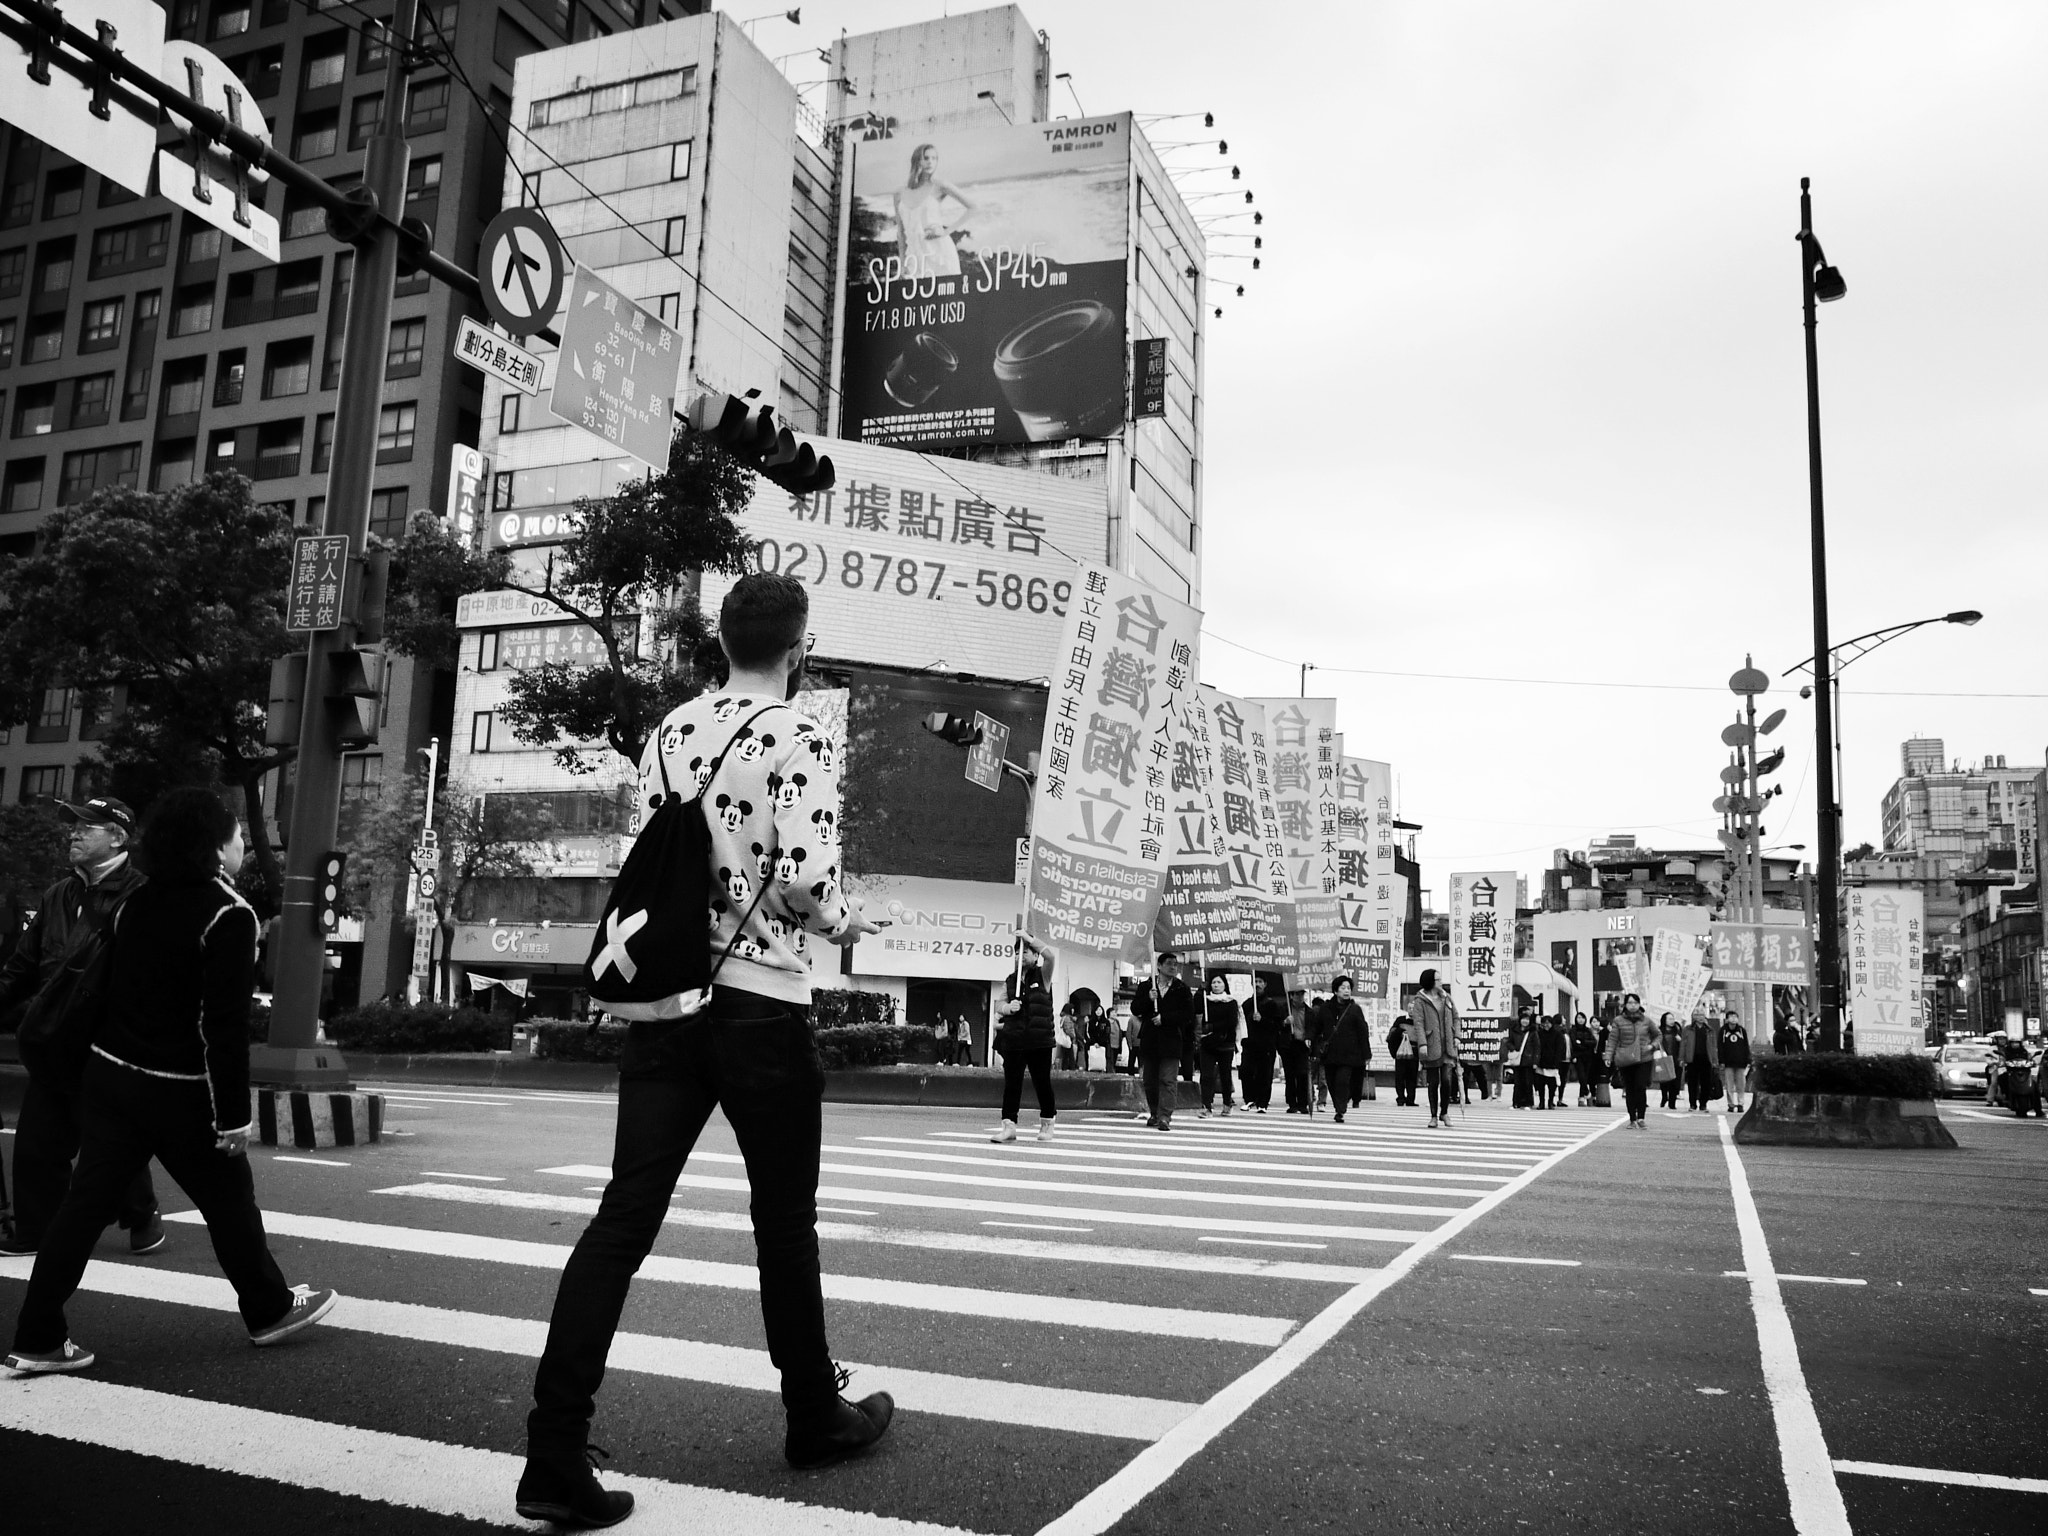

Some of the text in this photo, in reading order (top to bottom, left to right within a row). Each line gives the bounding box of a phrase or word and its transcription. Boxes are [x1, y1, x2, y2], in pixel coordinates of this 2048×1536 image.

[1043, 121, 1117, 141] TAMRON
[962, 271, 970, 294] &
[865, 301, 966, 332] F/1.8 Di VC USD
[607, 332, 619, 348] 32
[462, 329, 538, 388] 劃分島左側
[594, 341, 625, 369] 69-61
[584, 396, 619, 424] 124-130
[935, 410, 953, 420] NEW
[1147, 400, 1163, 412] 9F
[582, 413, 617, 440] 93-105
[789, 479, 1047, 557] 新據點廣告
[293, 539, 319, 628] 號誌行走
[315, 539, 341, 626] 行人請依
[421, 829, 437, 849] P
[2019, 828, 2032, 868] HOTEL
[418, 848, 433, 860] 25
[422, 880, 434, 891] 50
[916, 910, 986, 930] NEO
[1607, 915, 1635, 931] NET
[884, 938, 929, 952] 廣告上刊
[1714, 931, 1806, 970] 台灣獨立
[1714, 968, 1808, 982] TAIWAN INDEPENDENCE
